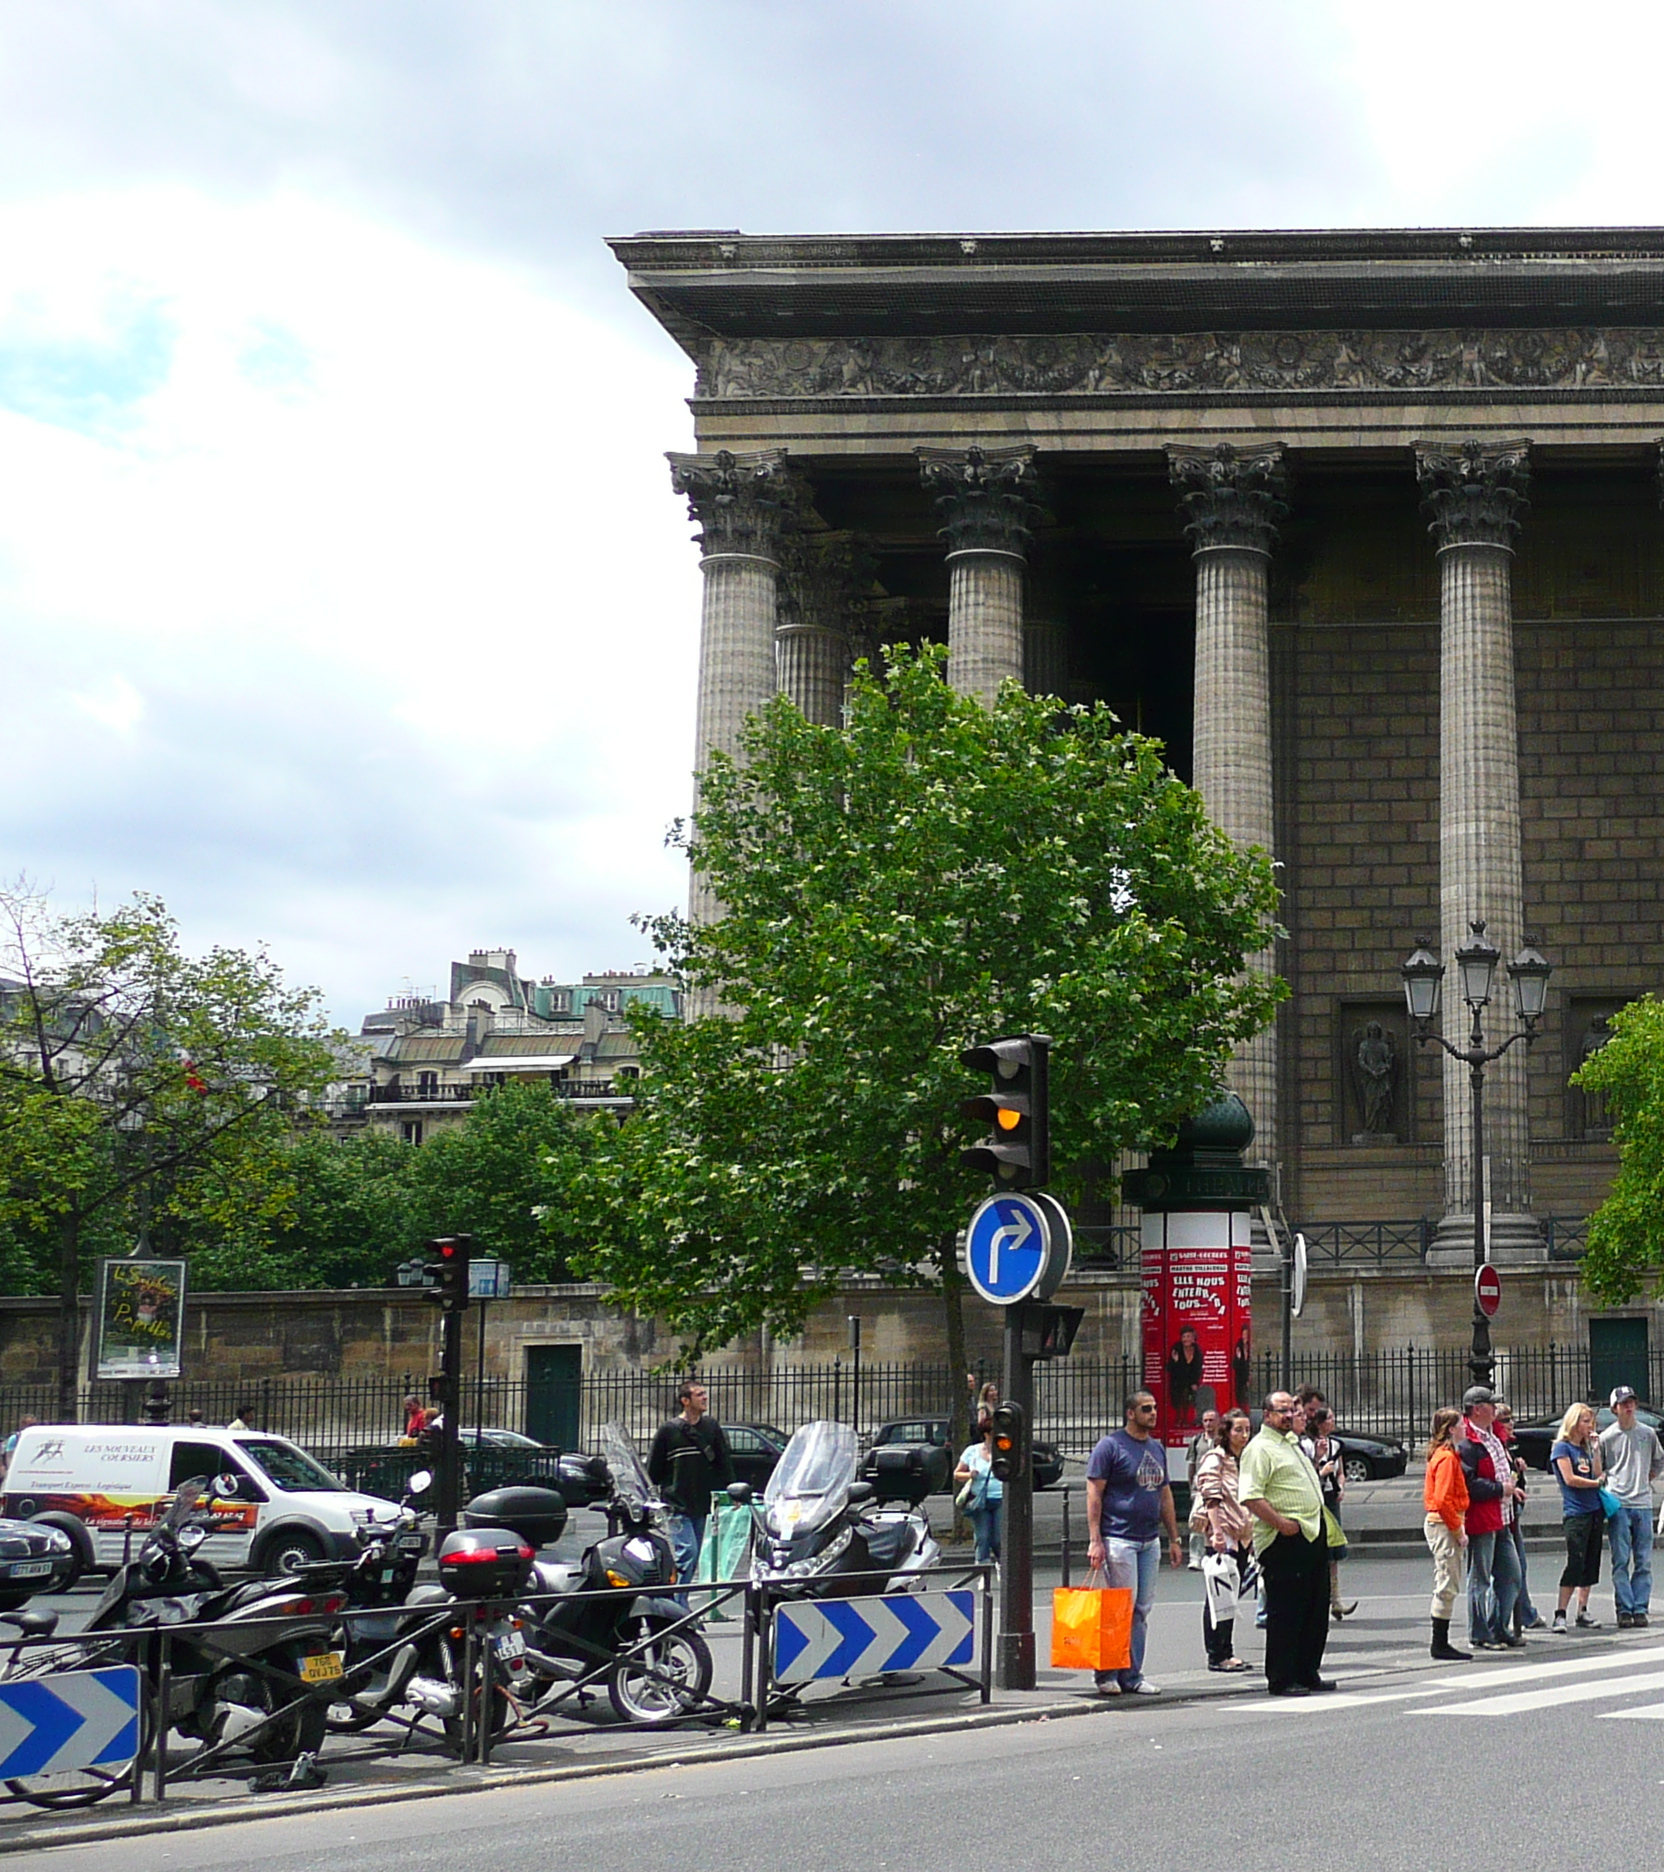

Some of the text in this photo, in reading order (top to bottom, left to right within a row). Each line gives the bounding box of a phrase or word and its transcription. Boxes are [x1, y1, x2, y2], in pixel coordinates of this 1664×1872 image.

[1173, 1275, 1226, 1287] ELLE NOUS
[84, 1444, 157, 1454] LES NOUVEAUX
[100, 1453, 155, 1463] COURSIERS
